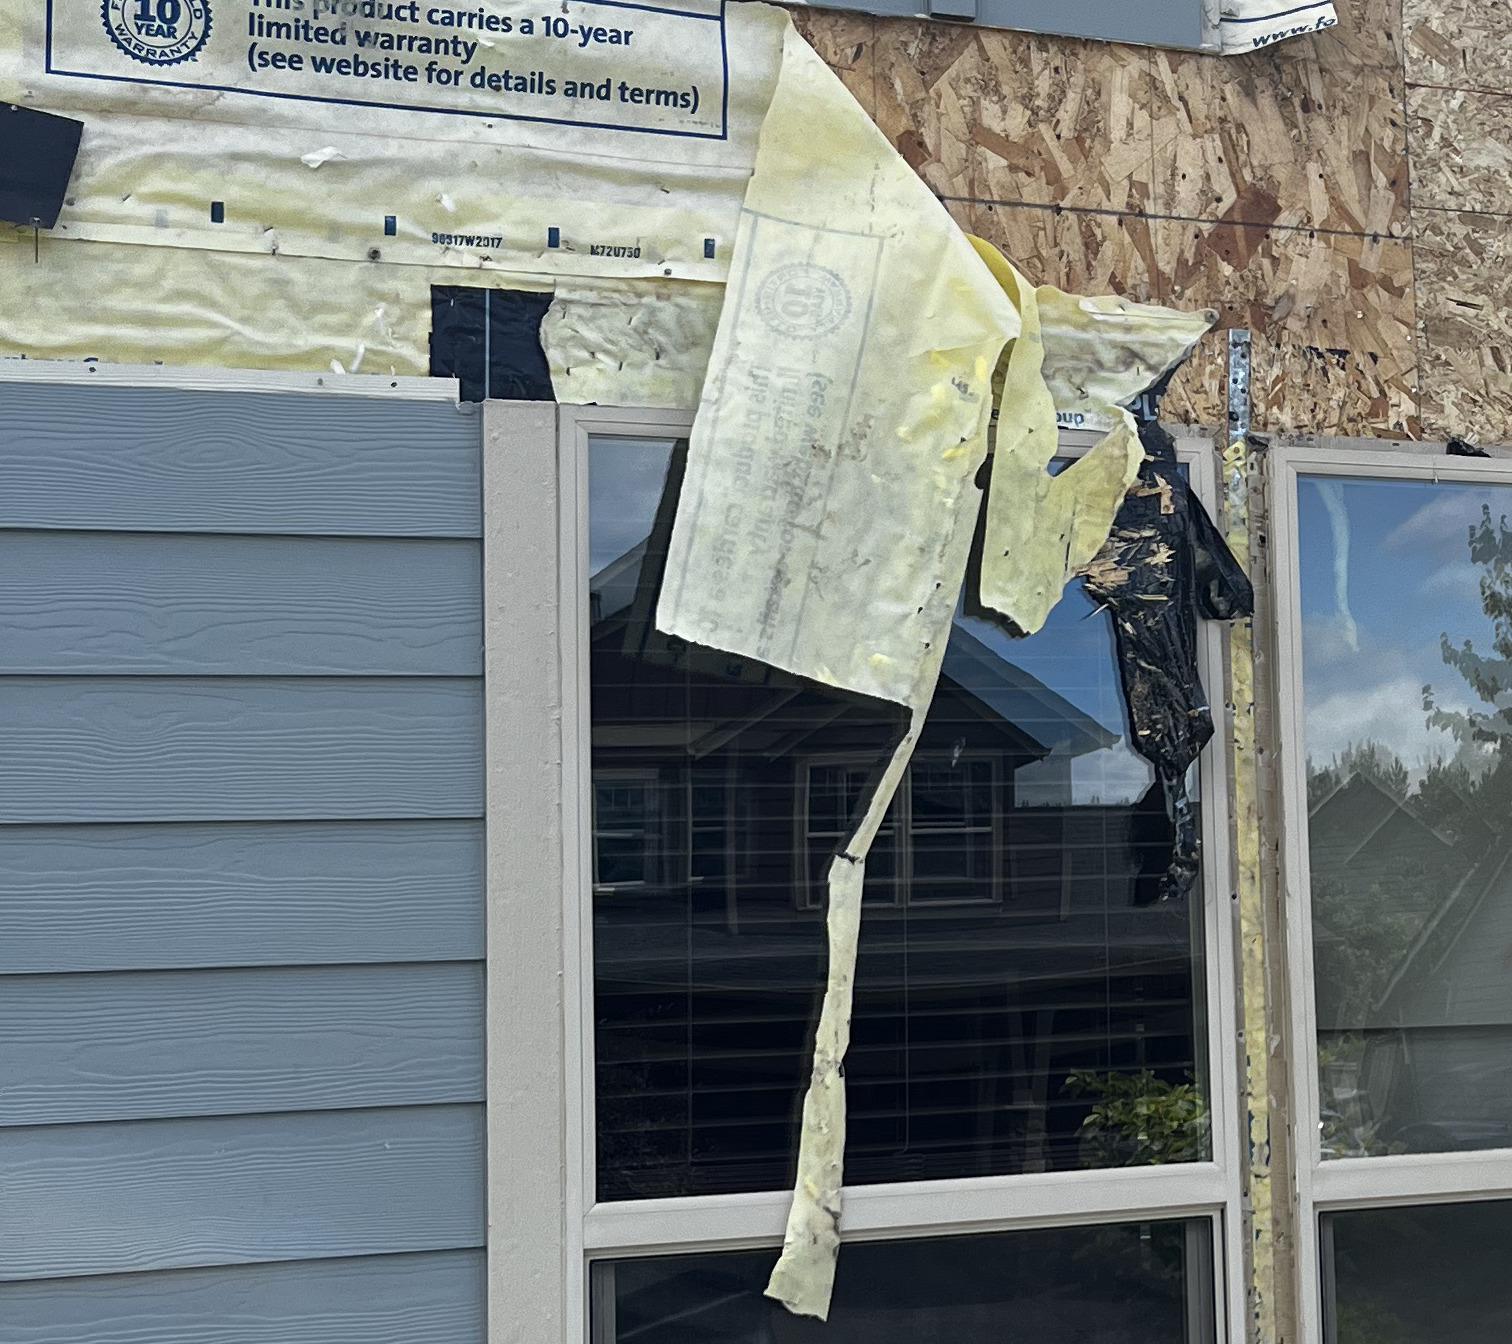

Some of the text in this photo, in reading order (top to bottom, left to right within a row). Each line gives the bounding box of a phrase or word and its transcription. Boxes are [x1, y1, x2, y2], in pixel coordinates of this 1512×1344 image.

[115, 23, 198, 59] WARRANTY
[134, 22, 178, 40] YEAR
[248, 12, 478, 65] limited warranty
[427, 7, 513, 33] carries
[519, 18, 534, 35] a
[542, 15, 634, 48] 10-year
[248, 42, 700, 115] (see website for details and terms)
